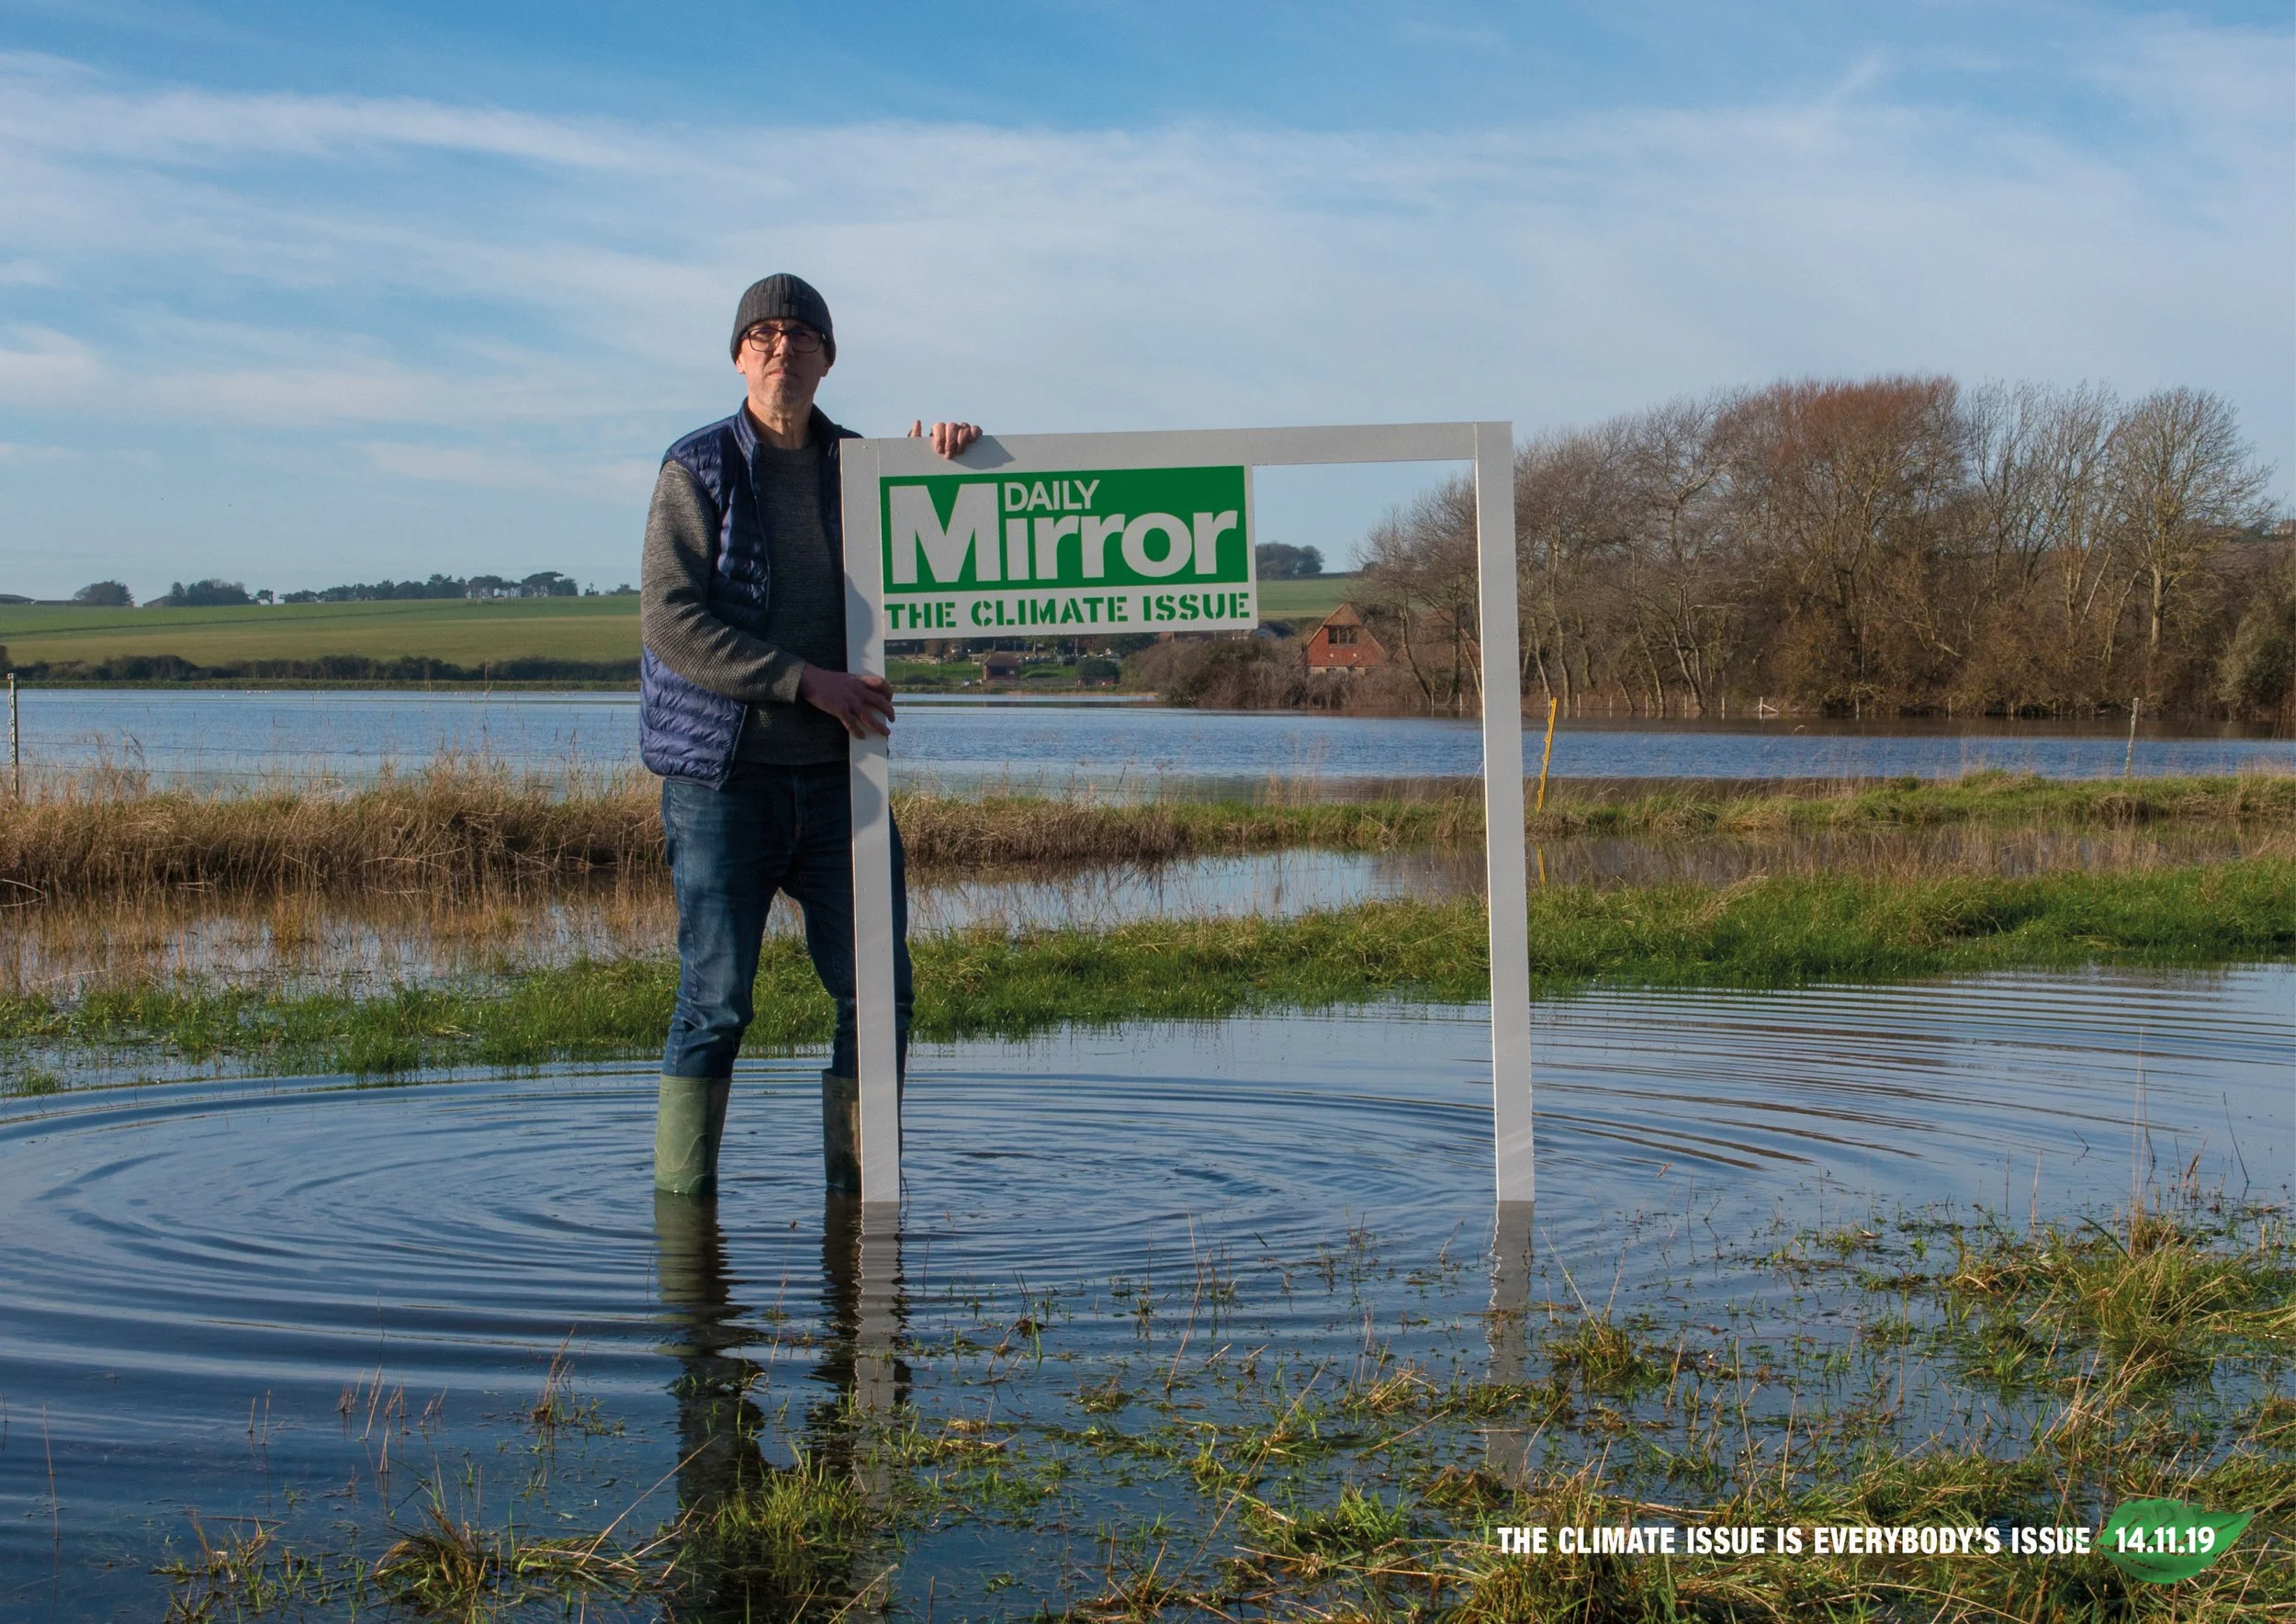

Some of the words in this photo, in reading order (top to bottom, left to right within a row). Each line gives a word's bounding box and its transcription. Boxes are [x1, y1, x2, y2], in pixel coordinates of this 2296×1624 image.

[1004, 479, 1100, 513] DAILY
[888, 482, 1238, 585] Mirror
[884, 603, 957, 630] THE
[971, 596, 1129, 627] CLIMATE
[1142, 592, 1250, 622] ISSUE
